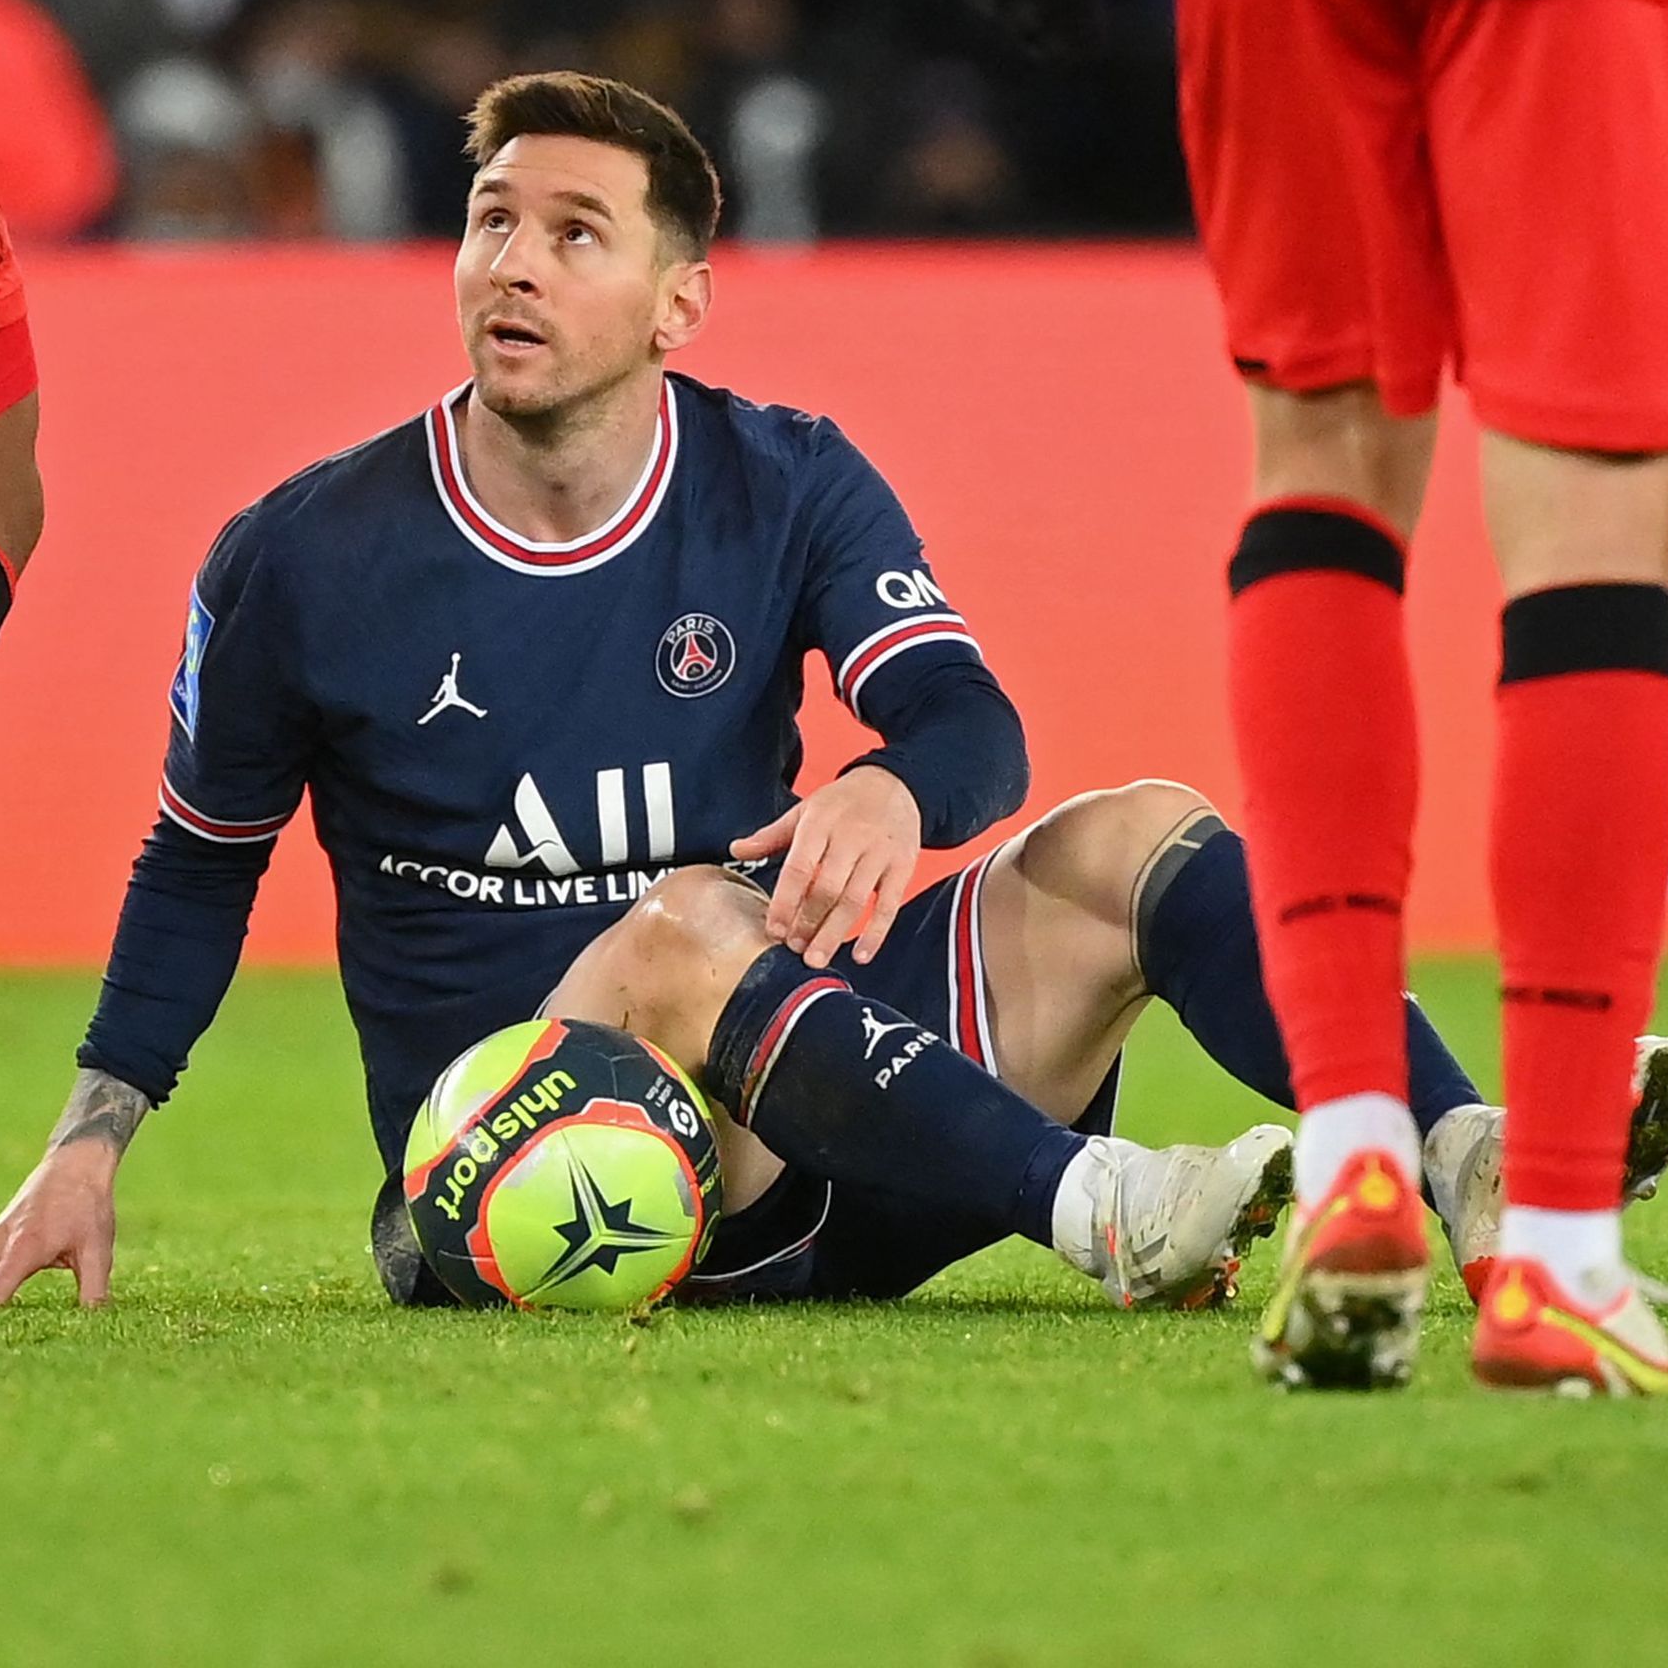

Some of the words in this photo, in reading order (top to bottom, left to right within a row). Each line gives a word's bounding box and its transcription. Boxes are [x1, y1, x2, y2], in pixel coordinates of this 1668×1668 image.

[666, 618, 716, 644] PARIS
[379, 853, 504, 905] ACCOR
[514, 876, 598, 906] LIVE
[435, 1069, 578, 1222] uhlsport
